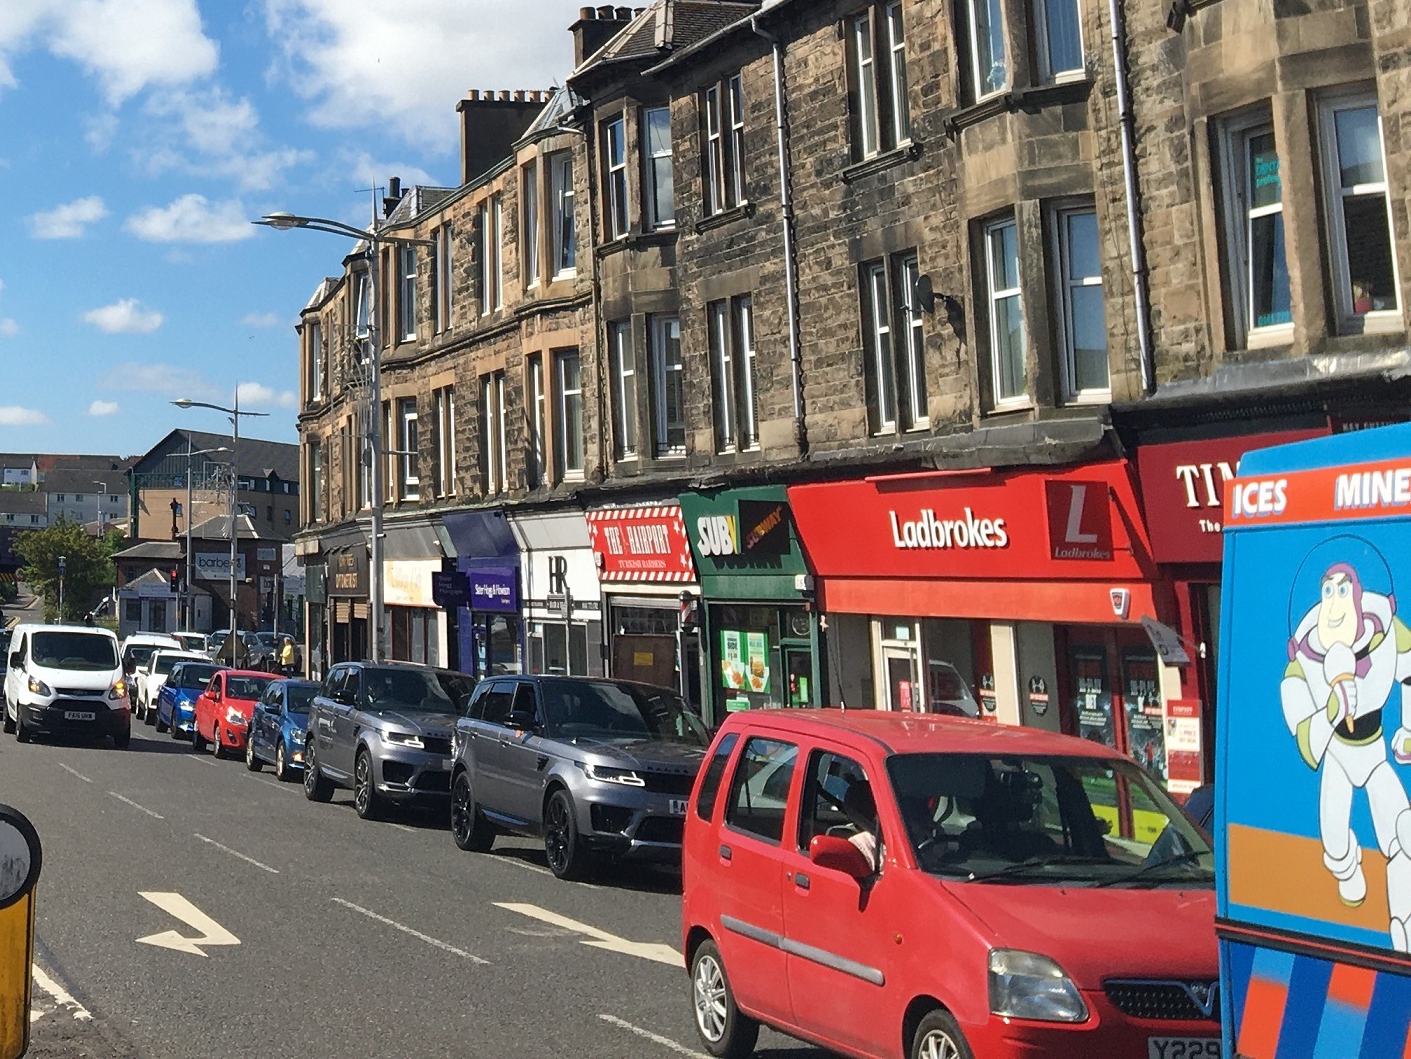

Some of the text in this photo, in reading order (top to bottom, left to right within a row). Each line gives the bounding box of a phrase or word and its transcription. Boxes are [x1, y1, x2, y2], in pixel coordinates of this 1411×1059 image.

[1065, 484, 1098, 543] L
[1233, 479, 1288, 518] ICES
[603, 524, 671, 555] THE HAIRPORT
[746, 505, 782, 549] SUBWAY
[889, 507, 1008, 551] Ladbrokes
[1199, 519, 1221, 533] The
[199, 557, 234, 568] barbe
[1055, 546, 1110, 559] Ladbrokes
